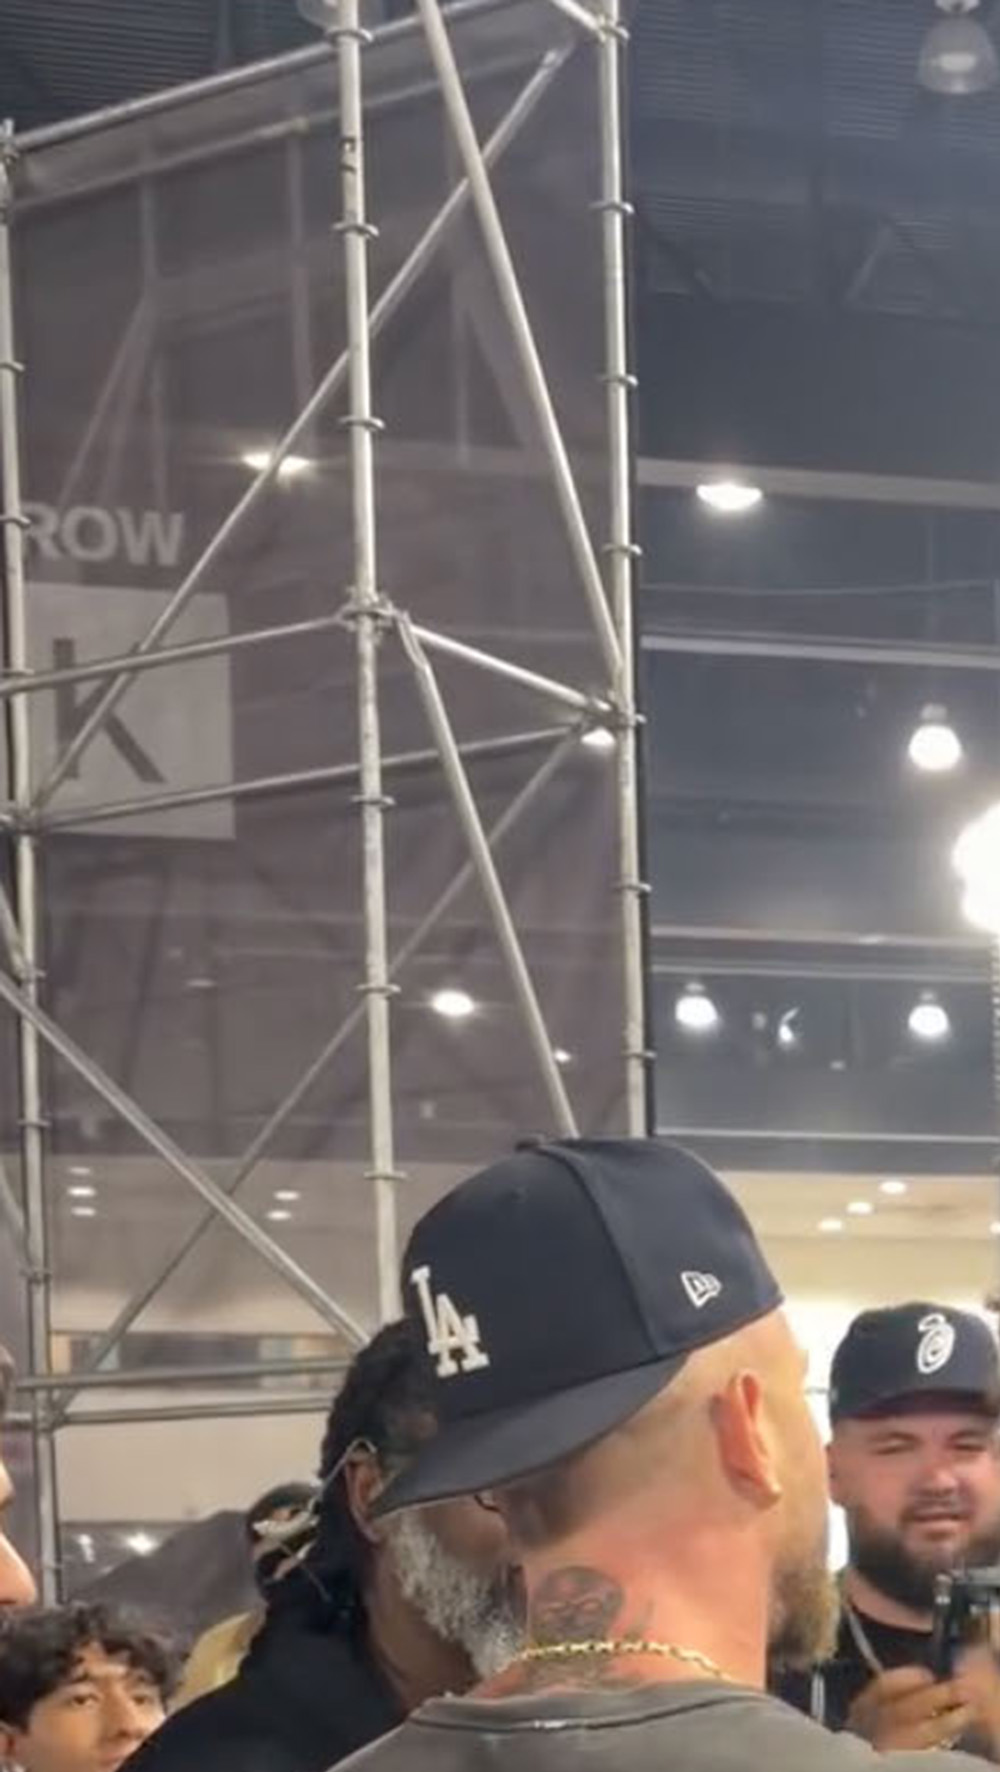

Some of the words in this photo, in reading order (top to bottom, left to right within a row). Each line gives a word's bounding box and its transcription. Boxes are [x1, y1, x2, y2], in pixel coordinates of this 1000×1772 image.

[19, 502, 184, 566] ROW
[53, 637, 166, 784] K
[410, 1265, 490, 1378] LA
